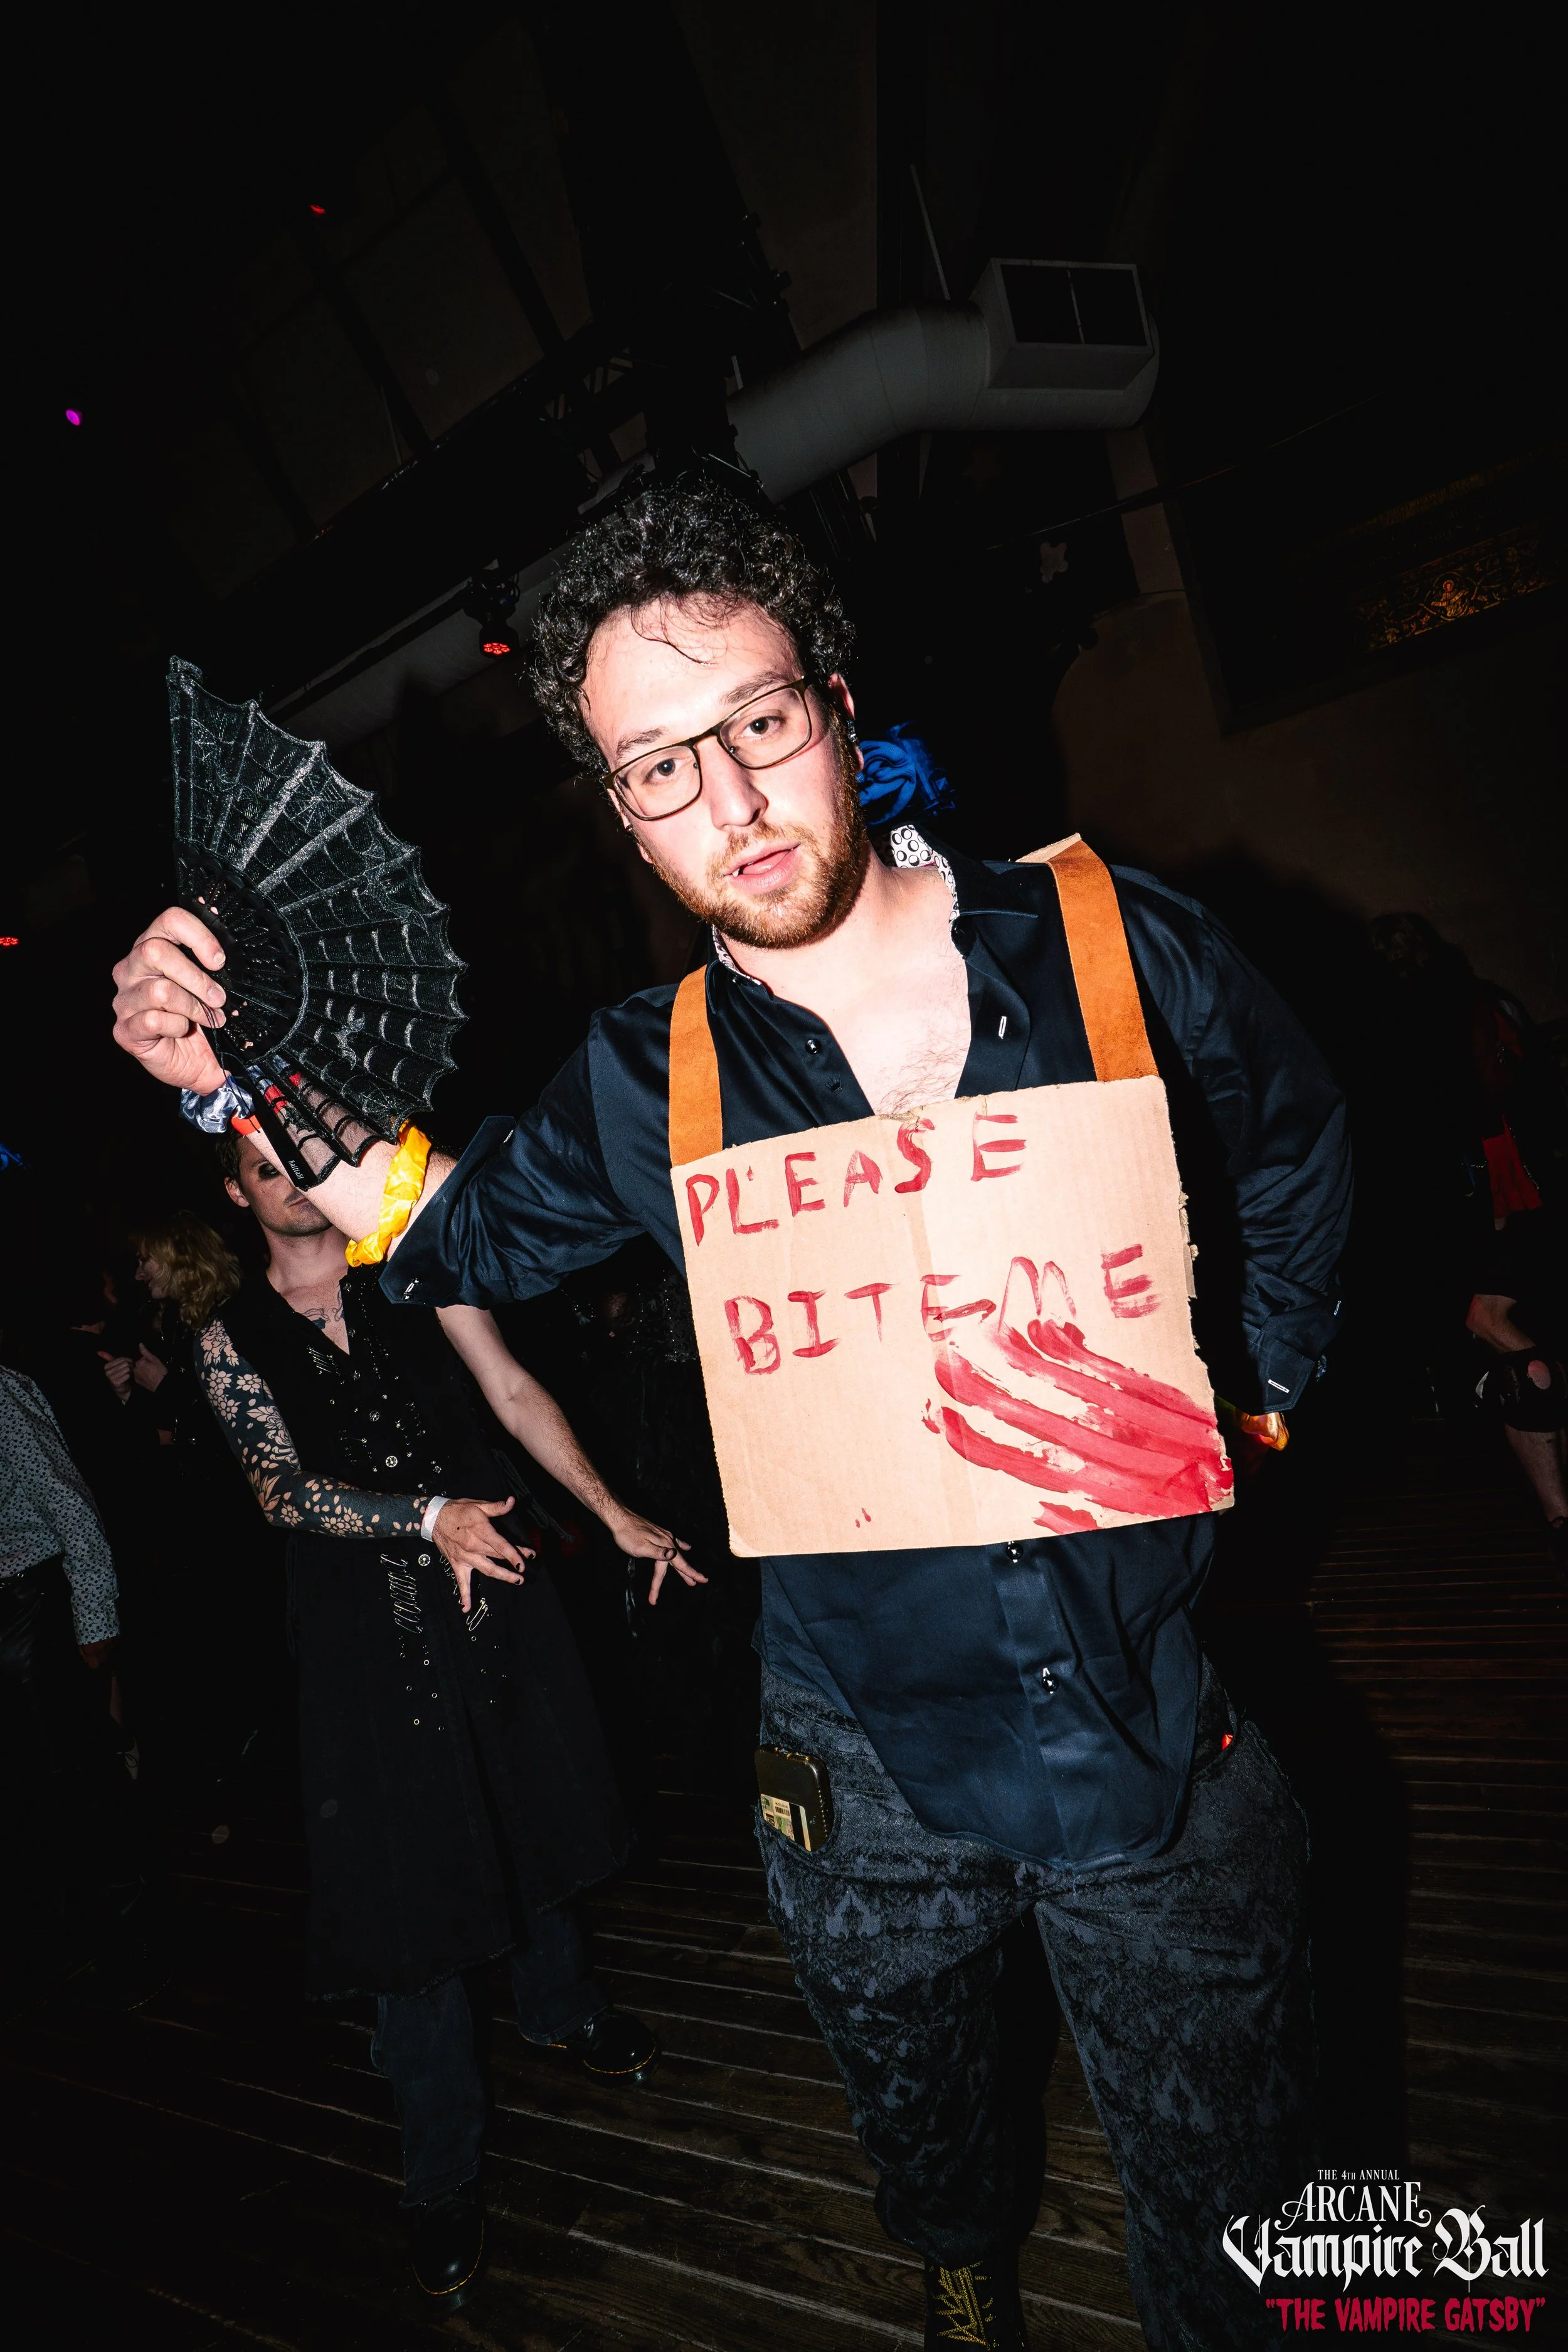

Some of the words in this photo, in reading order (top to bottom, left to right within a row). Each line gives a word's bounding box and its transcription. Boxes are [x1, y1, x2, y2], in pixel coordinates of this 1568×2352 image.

[685, 1111, 1027, 1246] PLEASE
[724, 1274, 997, 1375] BITE
[997, 1244, 1161, 1332] ME
